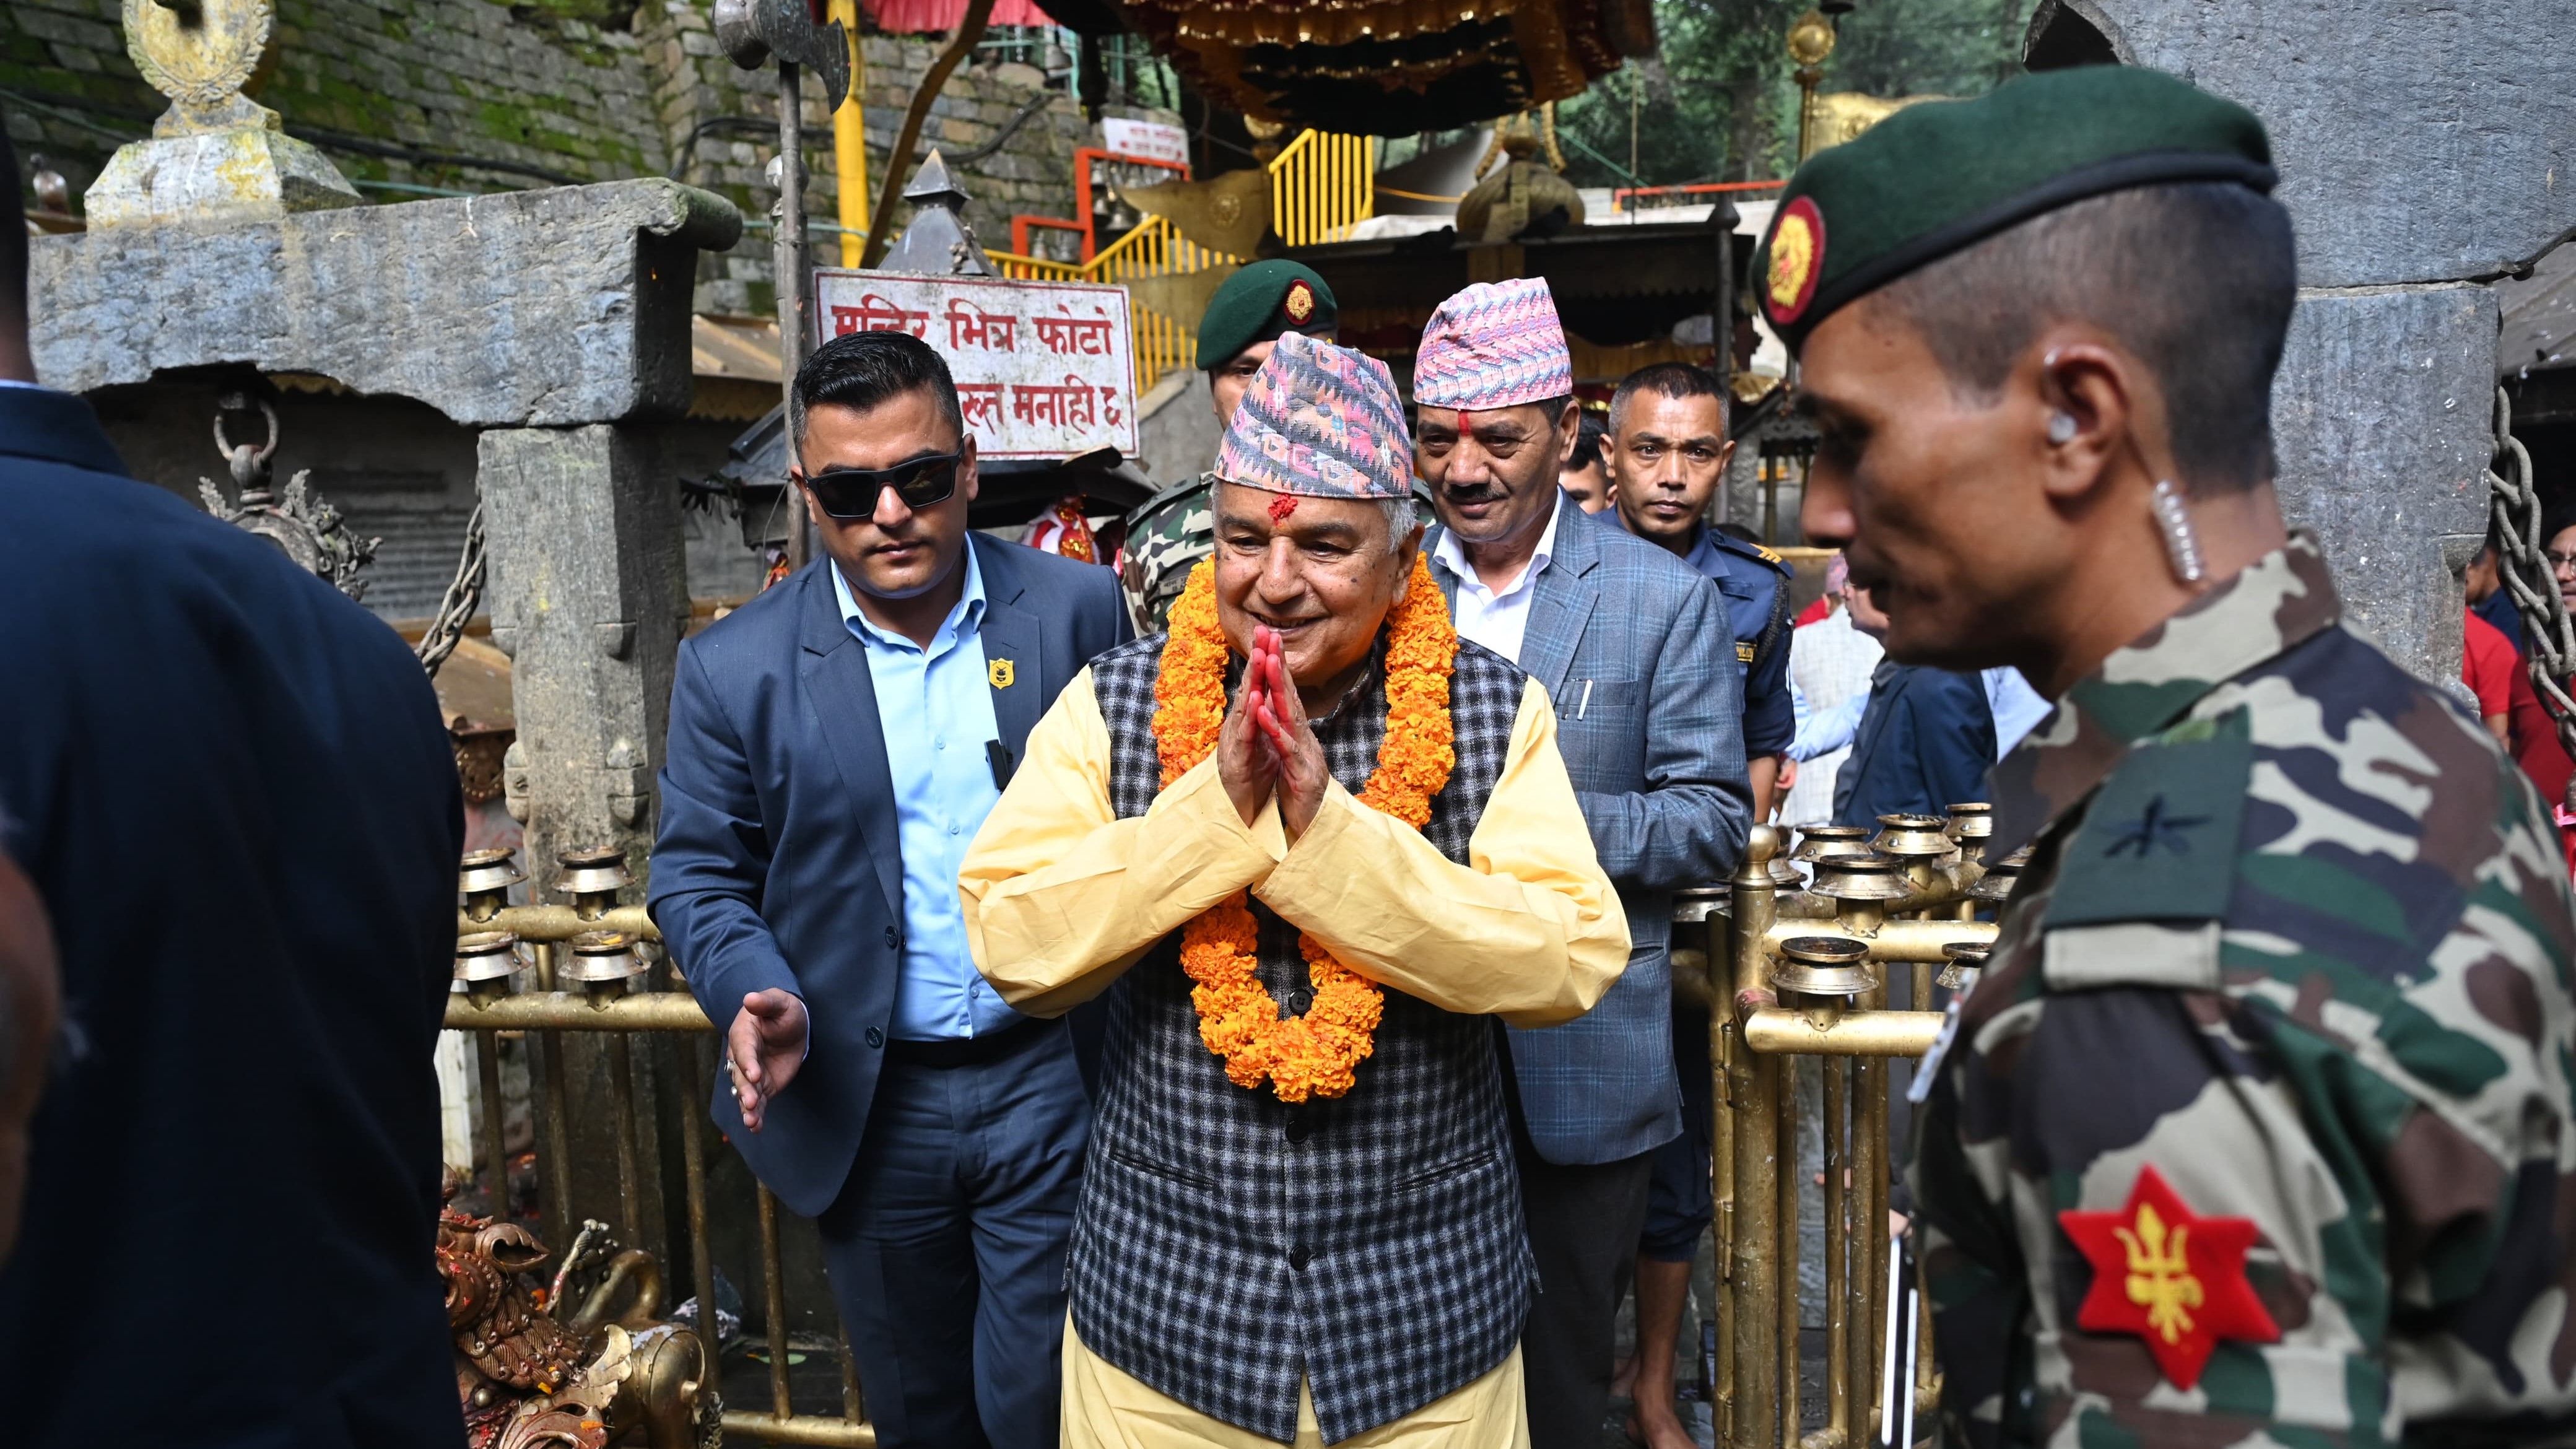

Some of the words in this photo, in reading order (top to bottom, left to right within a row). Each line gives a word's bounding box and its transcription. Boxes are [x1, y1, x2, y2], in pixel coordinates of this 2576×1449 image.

[944, 298, 1017, 352] भित्र
[1032, 304, 1113, 355] फोटो
[955, 383, 1004, 435] ख्त
[1012, 374, 1095, 434] मनाही
